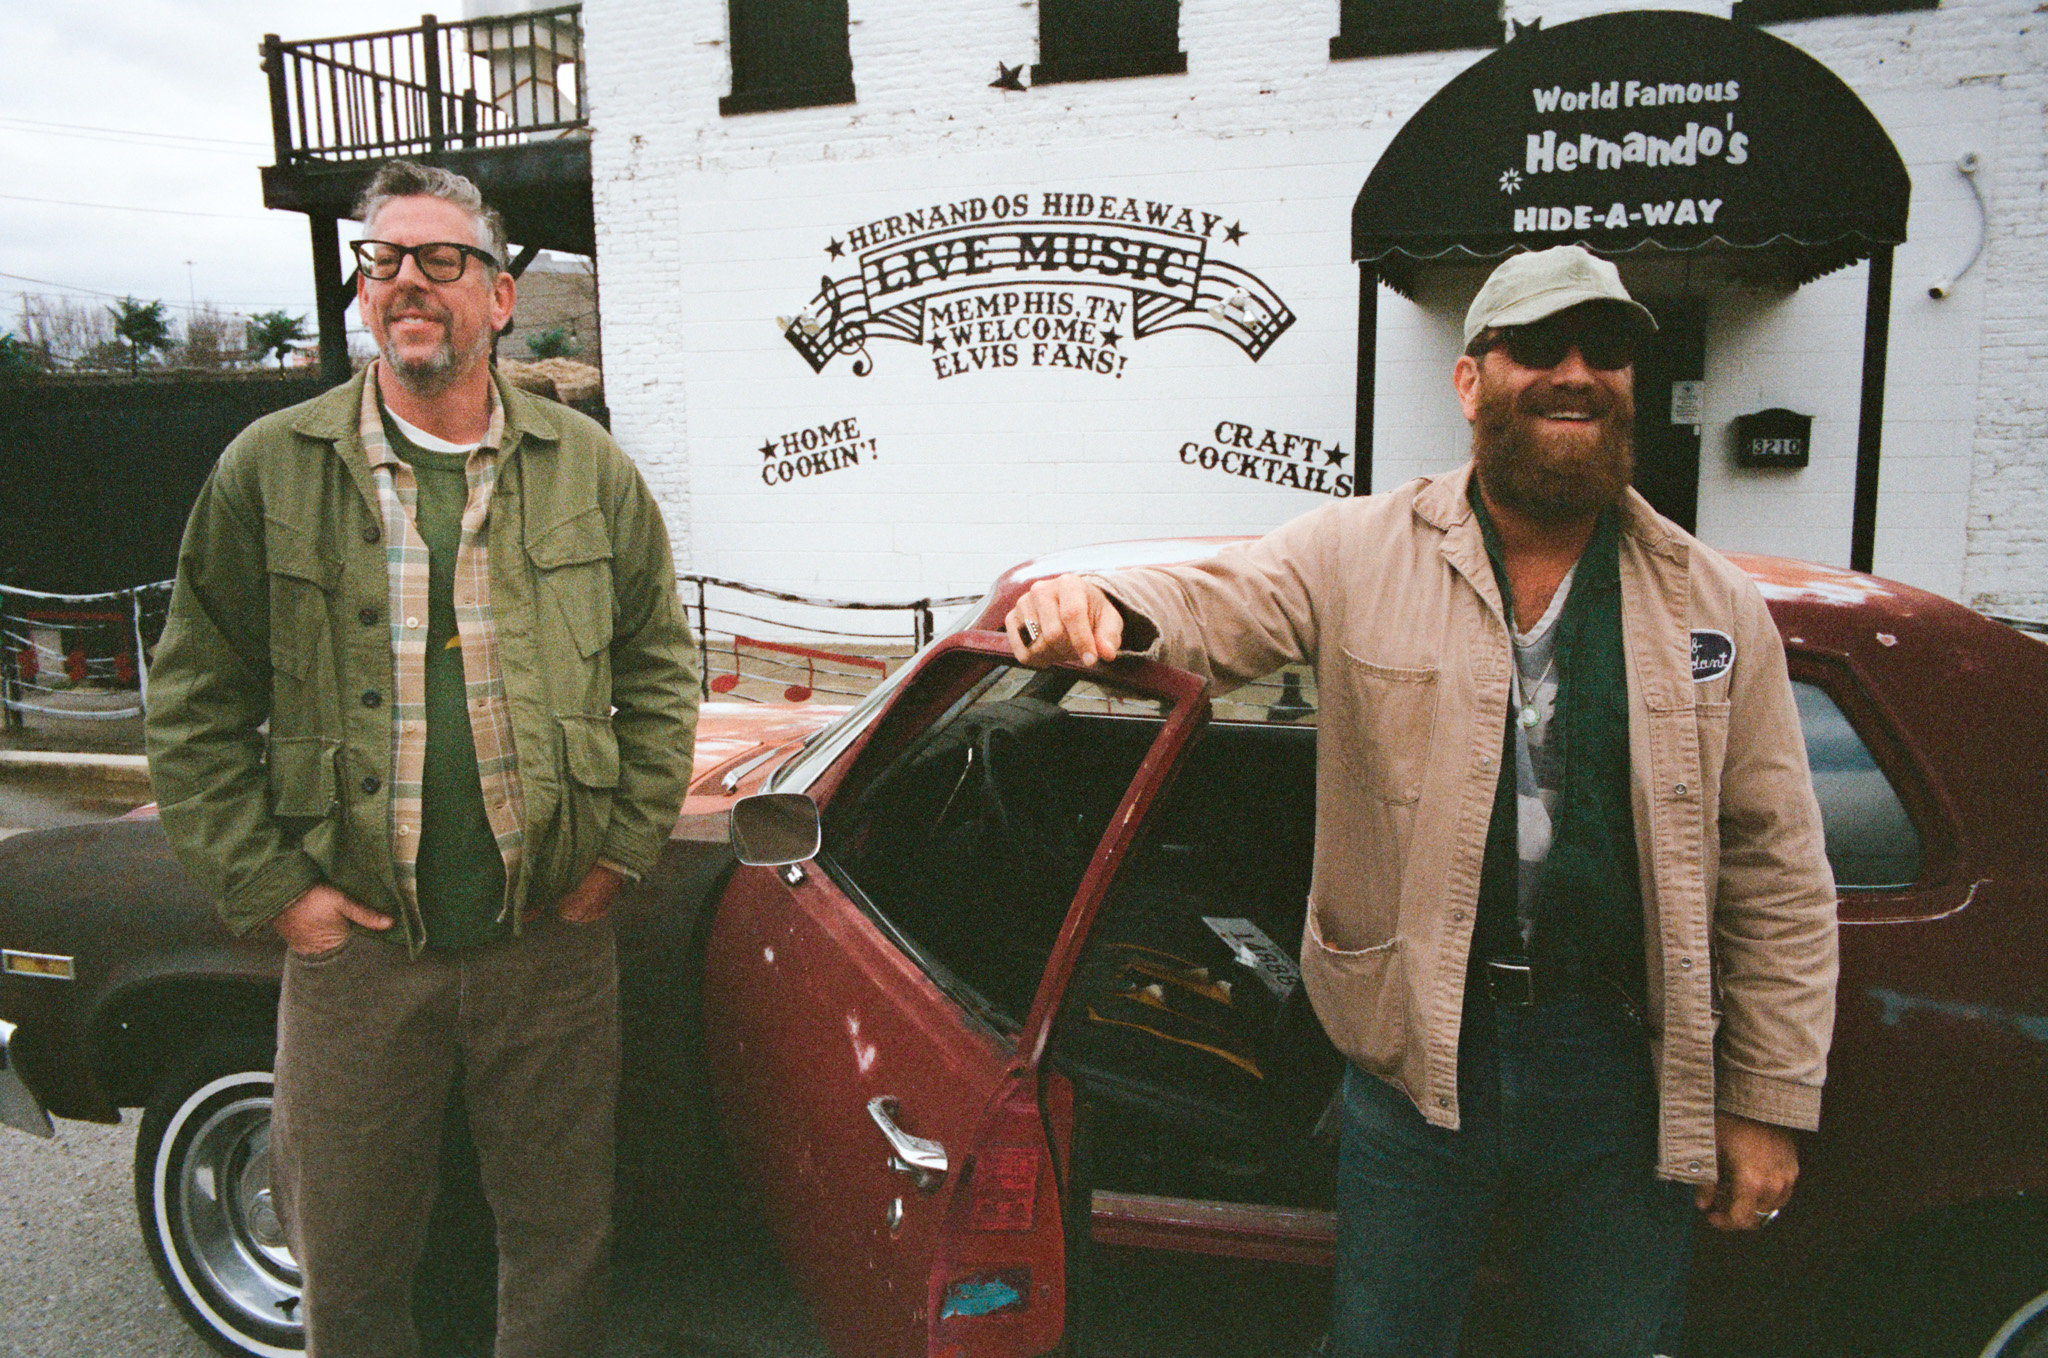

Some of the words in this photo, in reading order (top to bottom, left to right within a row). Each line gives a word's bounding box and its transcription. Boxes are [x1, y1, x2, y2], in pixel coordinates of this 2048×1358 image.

[1532, 81, 1620, 113] World
[1624, 80, 1740, 108] Famous
[1526, 112, 1749, 174] Hernando's
[847, 193, 1029, 252] HERNANDOS
[1041, 192, 1222, 237] HIDEAWAY
[1513, 198, 1723, 232] HIDE-A-WAY
[873, 235, 994, 296] LIVE
[1015, 232, 1189, 287] MUSIC
[949, 317, 1096, 347] WELCOME
[932, 343, 1018, 379] ELVIS
[1032, 343, 1128, 379] FANS!
[780, 417, 860, 456] HOME
[1214, 420, 1322, 462] CRAFT
[1752, 438, 1800, 455] 3210
[1179, 442, 1354, 498] COCKTAILS
